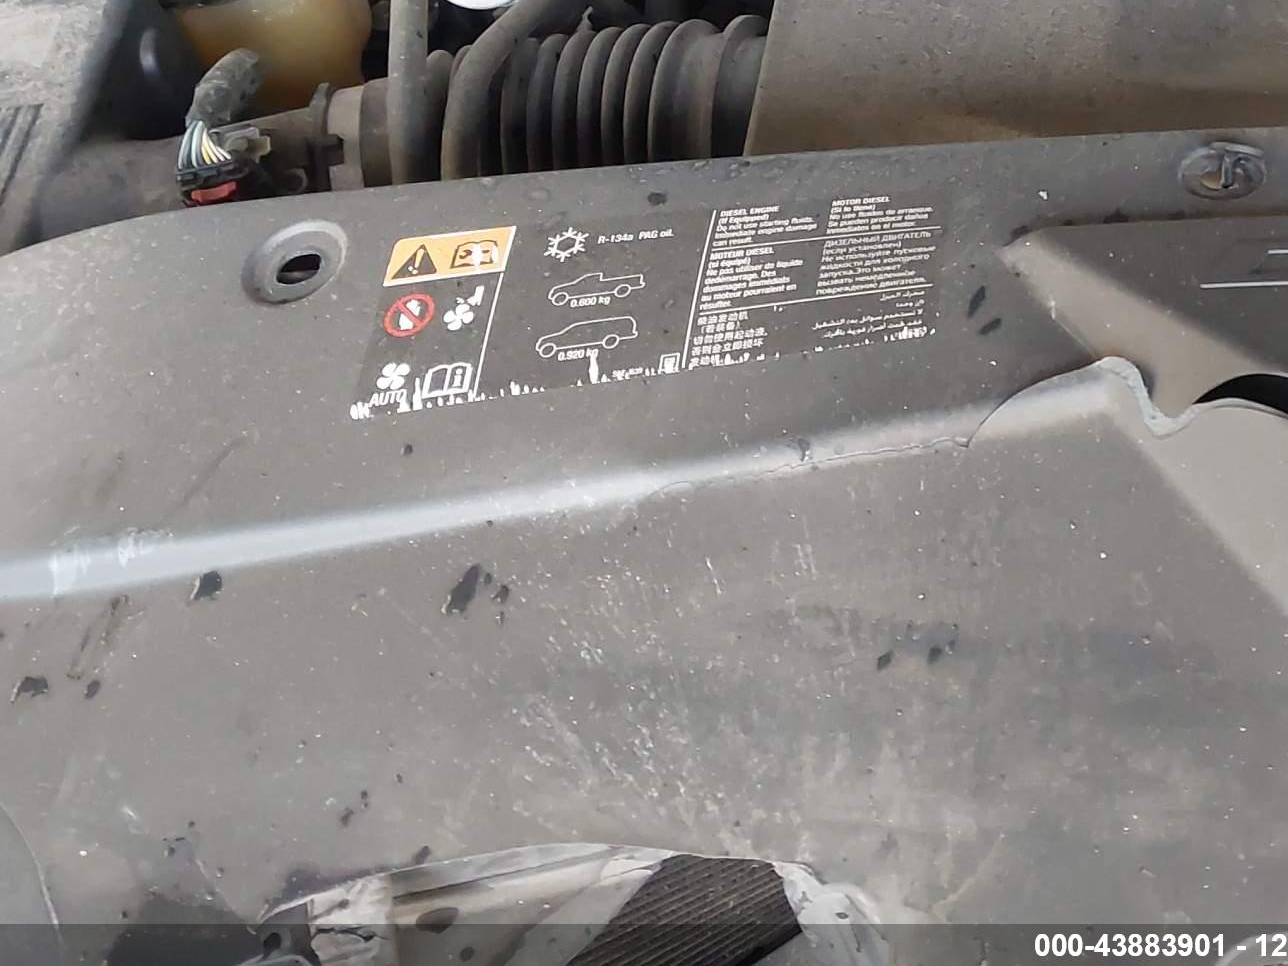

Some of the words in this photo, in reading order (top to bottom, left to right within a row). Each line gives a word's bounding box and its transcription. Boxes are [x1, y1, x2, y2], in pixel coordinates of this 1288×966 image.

[720, 209, 748, 217] DIESEL
[750, 205, 780, 214] ENGINE
[598, 234, 633, 244] R-134a
[639, 230, 658, 240] PAG
[710, 250, 744, 260] MOTEUR
[746, 247, 774, 256] DIESEL
[598, 296, 611, 306] kg
[558, 350, 584, 361] 0.920
